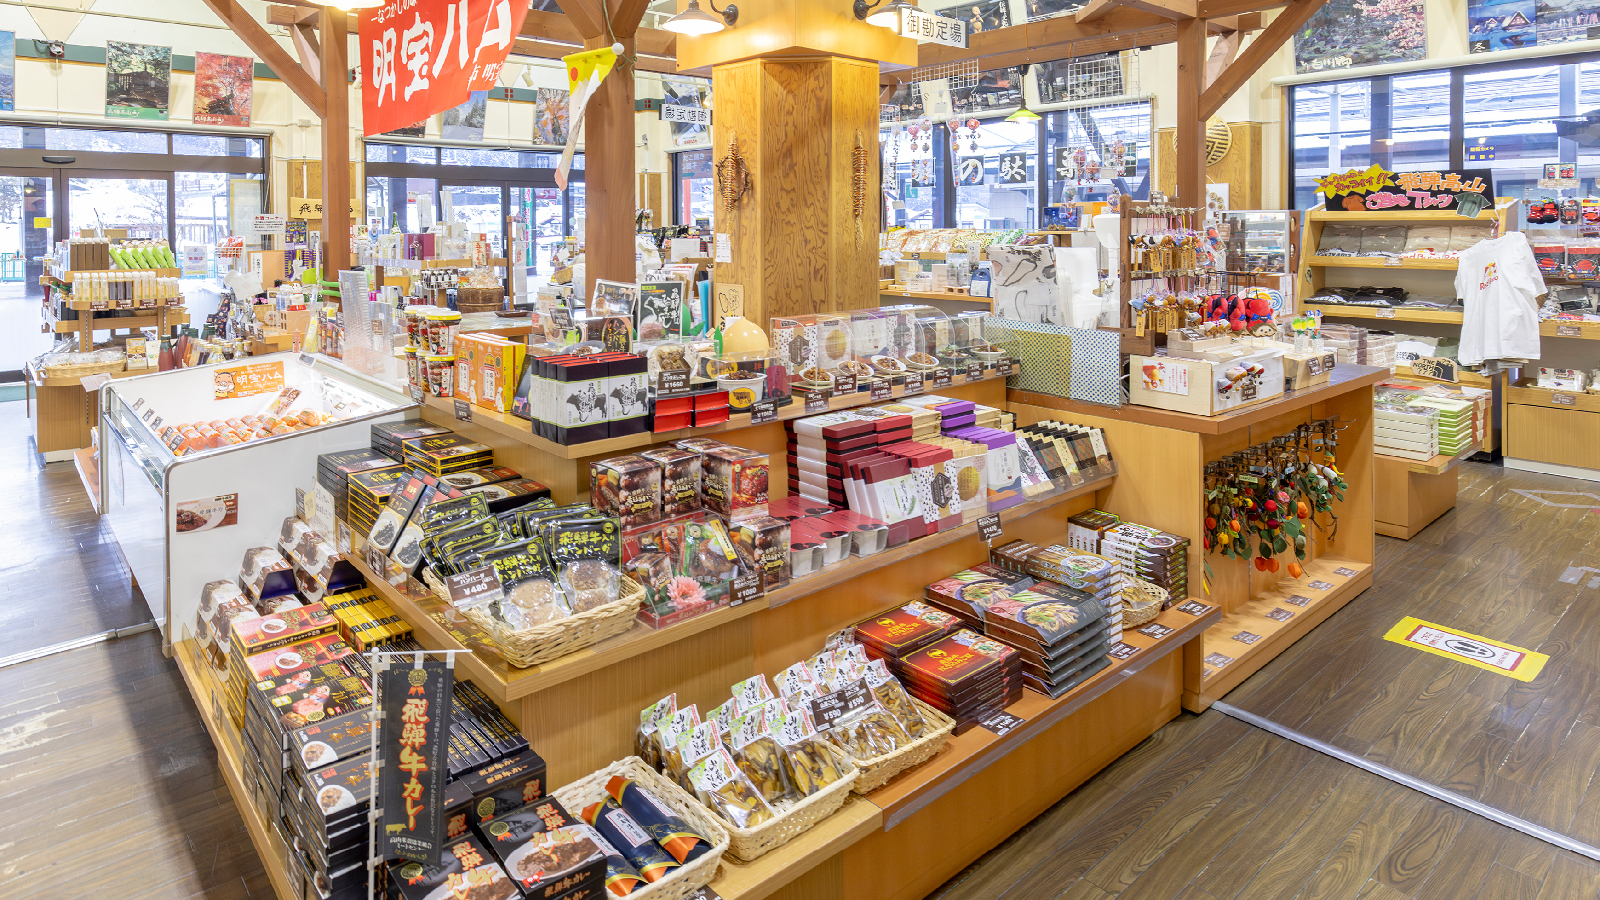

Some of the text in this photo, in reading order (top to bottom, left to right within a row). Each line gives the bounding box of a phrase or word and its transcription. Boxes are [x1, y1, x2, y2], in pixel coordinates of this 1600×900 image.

[907, 8, 962, 43] 御勘定場
[372, 0, 512, 108] 明宝ハム
[1474, 42, 1486, 52] 冬
[959, 157, 984, 183] の
[1001, 155, 1027, 181] 駄
[1396, 171, 1488, 193] 飛騨高山
[1412, 363, 1436, 372] NORTH
[236, 371, 283, 385] 明宝ハム
[558, 531, 615, 546] 飛騨牛入り
[463, 583, 488, 596] ¥480
[737, 586, 757, 598] ¥1080
[847, 696, 865, 709] ¥590
[823, 709, 842, 721] ¥590
[398, 698, 430, 832] 飛騨牛カレー
